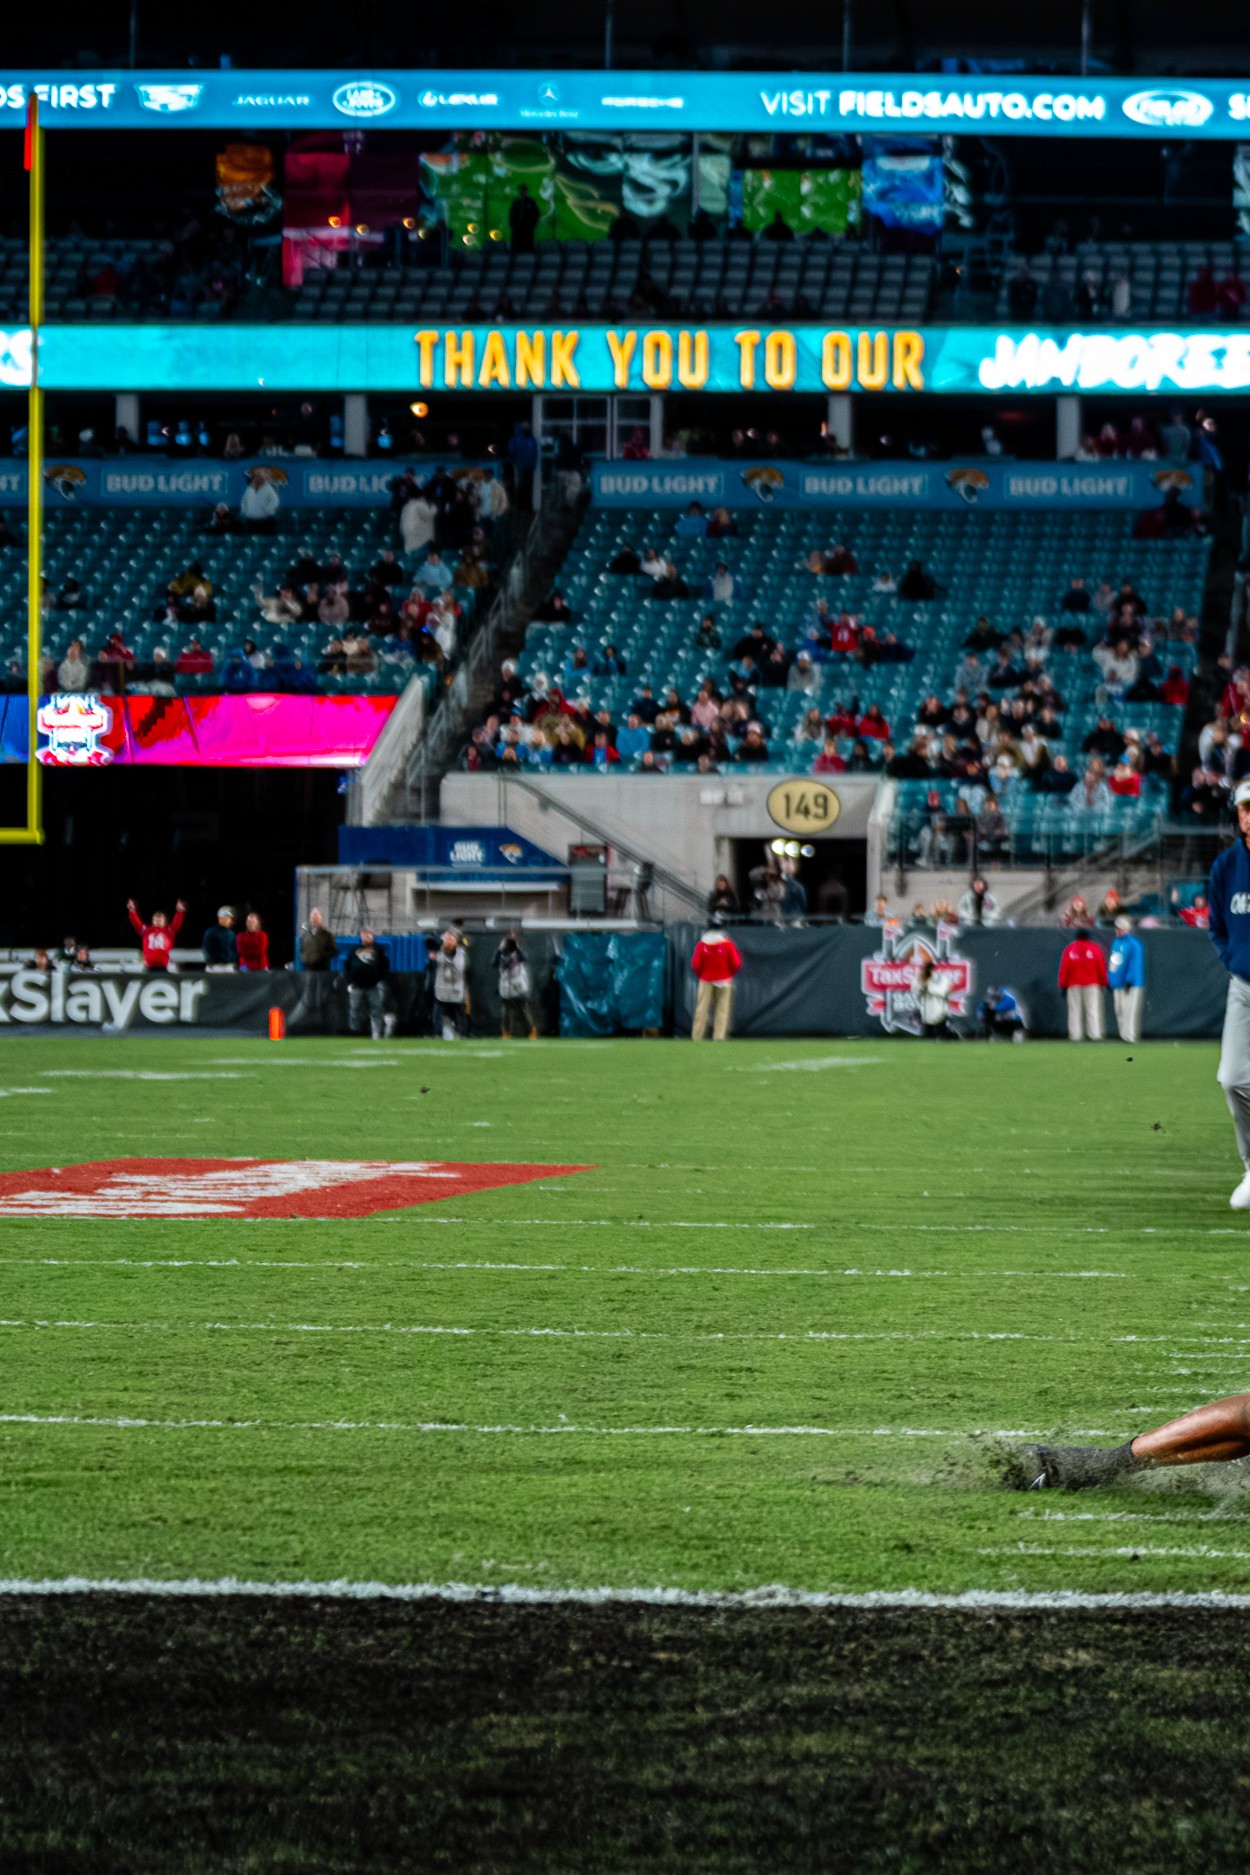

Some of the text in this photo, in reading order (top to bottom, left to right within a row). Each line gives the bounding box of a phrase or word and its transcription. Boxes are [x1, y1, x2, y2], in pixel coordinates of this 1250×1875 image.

[34, 84, 116, 109] FIRST
[760, 90, 832, 116] VISIT
[838, 91, 1107, 121] FIELDSAUTO.COM
[415, 330, 925, 390] THANK YOU TO OUR
[107, 474, 222, 493] BUD LIGHT
[309, 474, 356, 493] BUD
[601, 474, 718, 494] BUD LIGHT
[805, 476, 923, 496] BUD LIGHT
[1010, 476, 1129, 496] BUD LIGHT
[784, 791, 828, 820] 149
